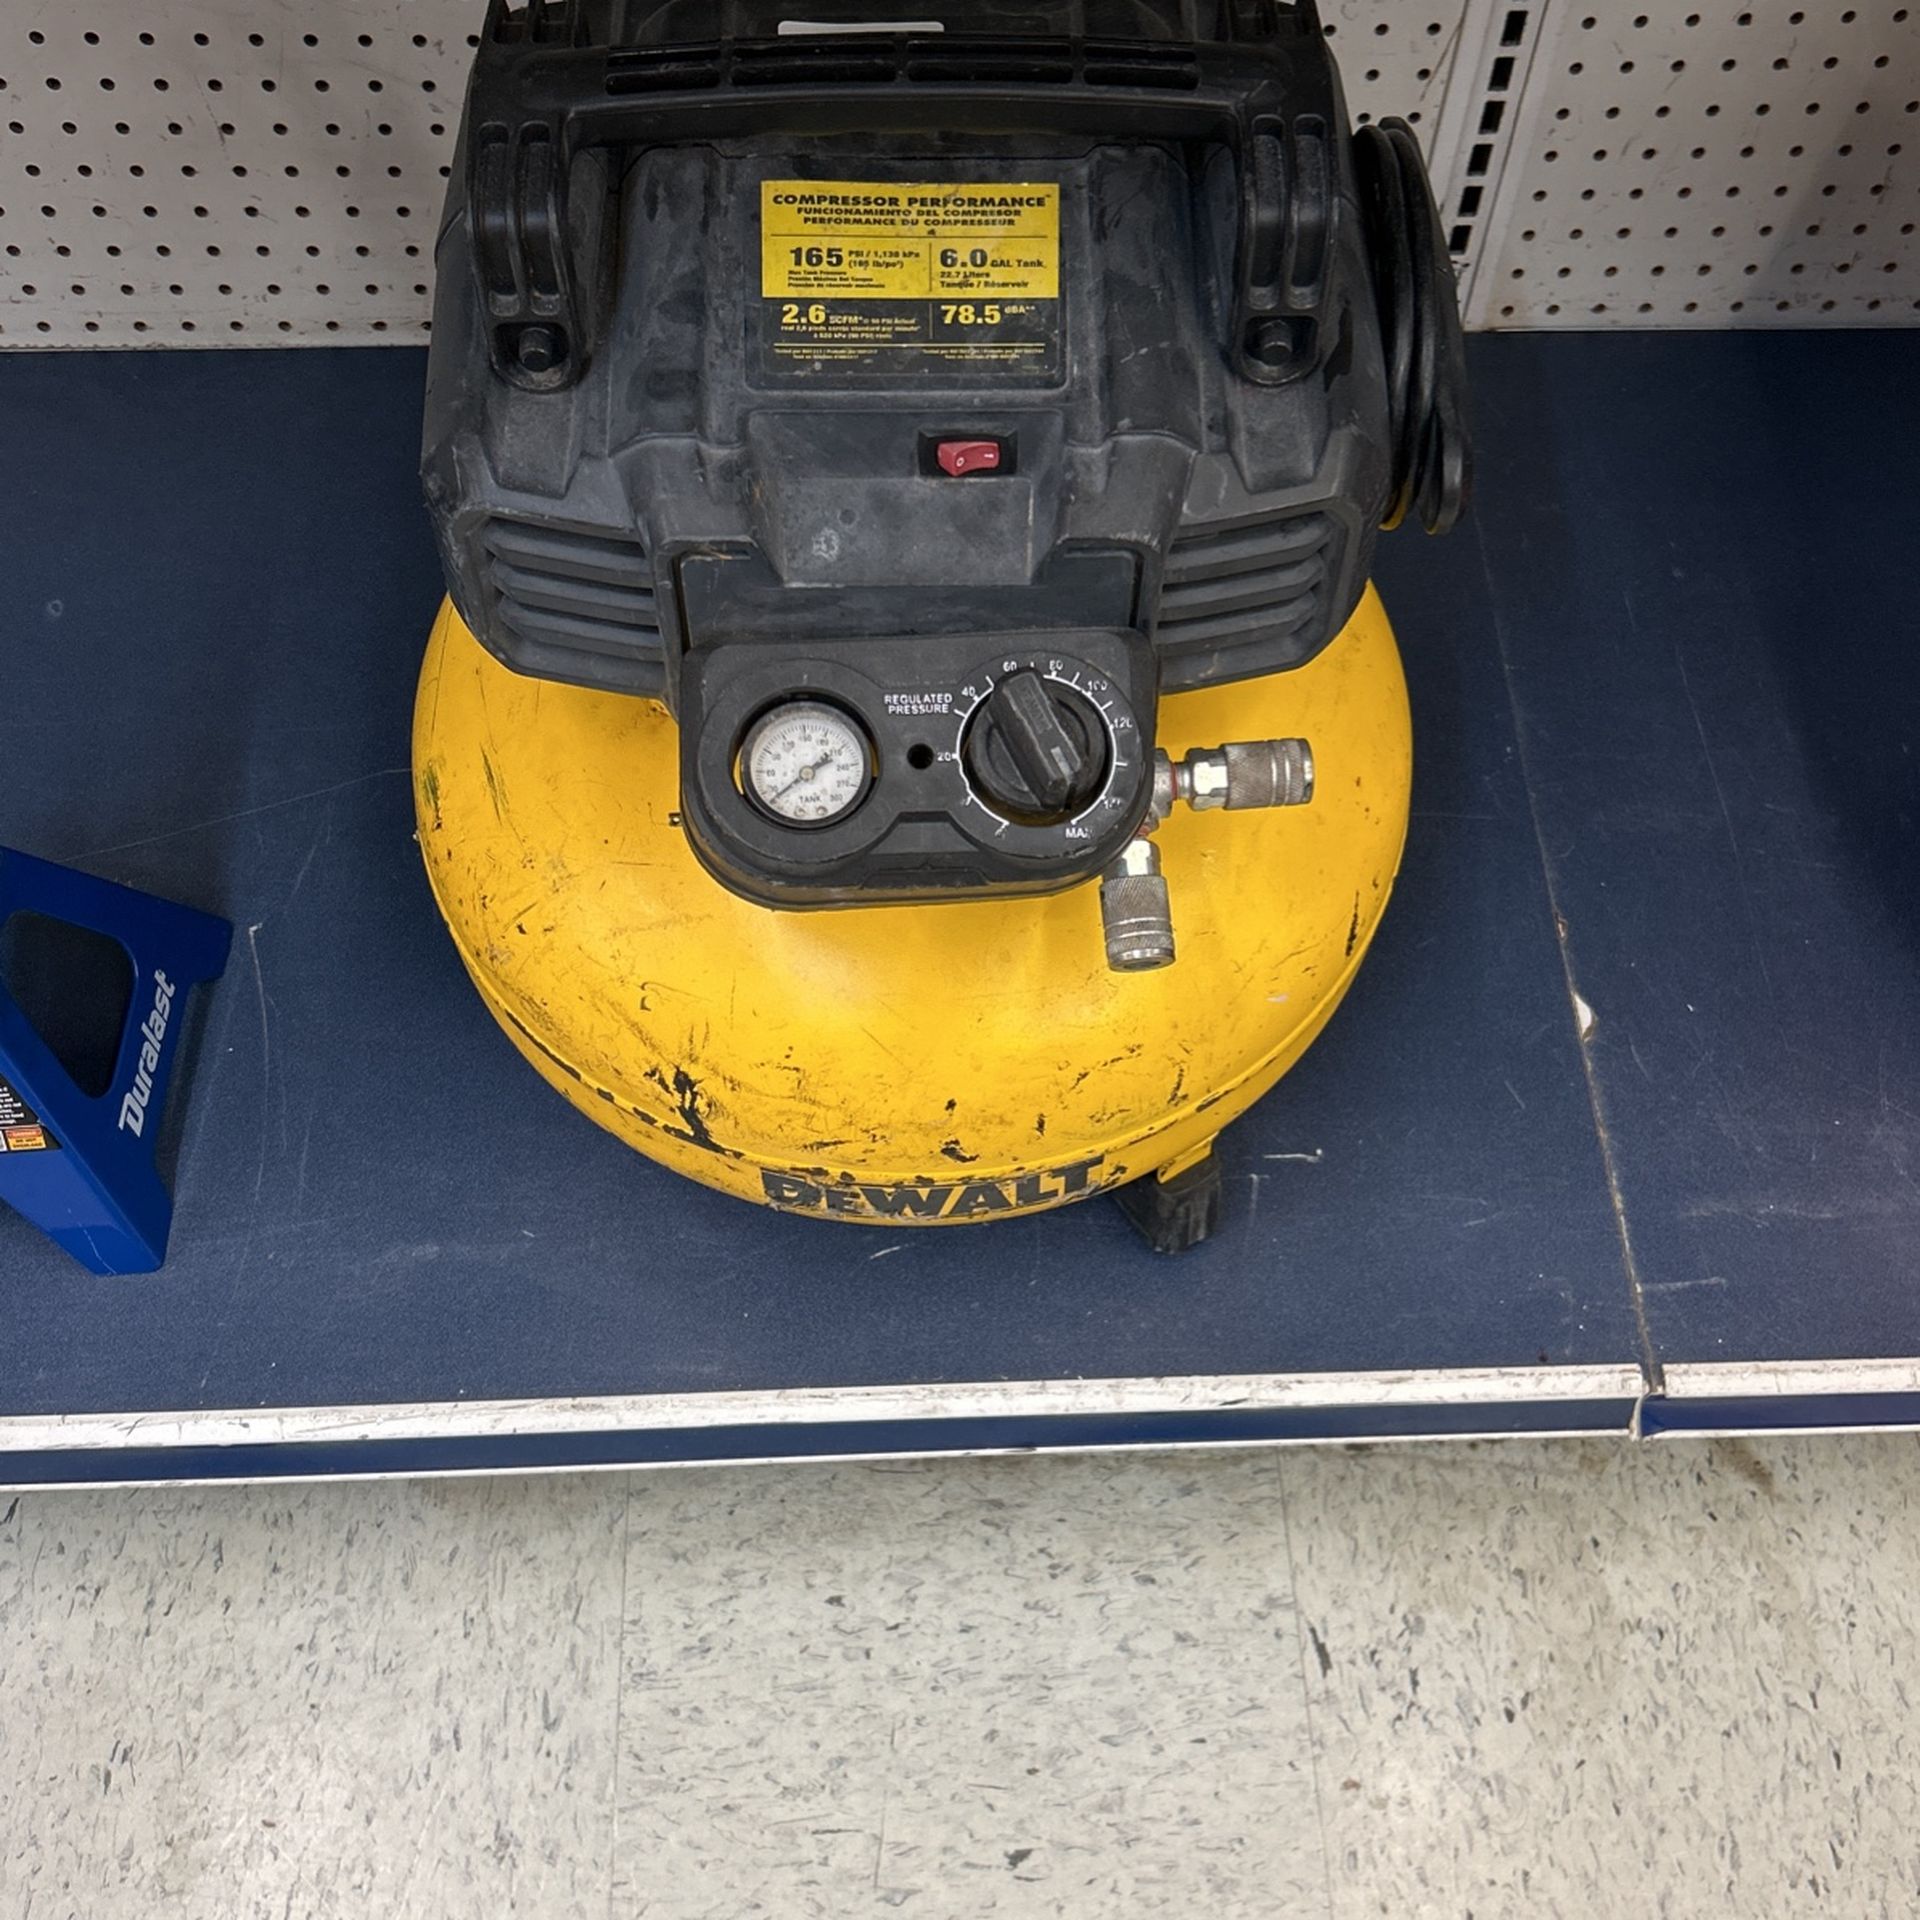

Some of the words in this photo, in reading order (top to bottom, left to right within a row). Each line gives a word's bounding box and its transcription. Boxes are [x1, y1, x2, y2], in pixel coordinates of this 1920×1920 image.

[772, 194, 900, 207] COMPRESSOR
[907, 196, 1046, 208] PERFORMANCE
[797, 207, 912, 217] FUNCIONAMIENTO
[916, 209, 939, 217] DEL
[943, 209, 1022, 217] COMPRESOR
[803, 217, 897, 226] PERFORMANCE
[901, 218, 919, 226] DU
[924, 218, 1016, 226] COMPRESSEUR
[789, 246, 844, 267] 165
[939, 248, 988, 268] 6.0
[990, 259, 1013, 268] GAL
[781, 303, 826, 325] 2.6
[940, 304, 1002, 325] 78.5
[884, 692, 953, 705] REGULATED
[961, 686, 976, 698] 40
[888, 703, 949, 715] PRESSURE
[937, 751, 951, 762] 20
[799, 795, 821, 803] TANK
[118, 969, 176, 1138] Duralast
[760, 1153, 1105, 1217] DEWALT
